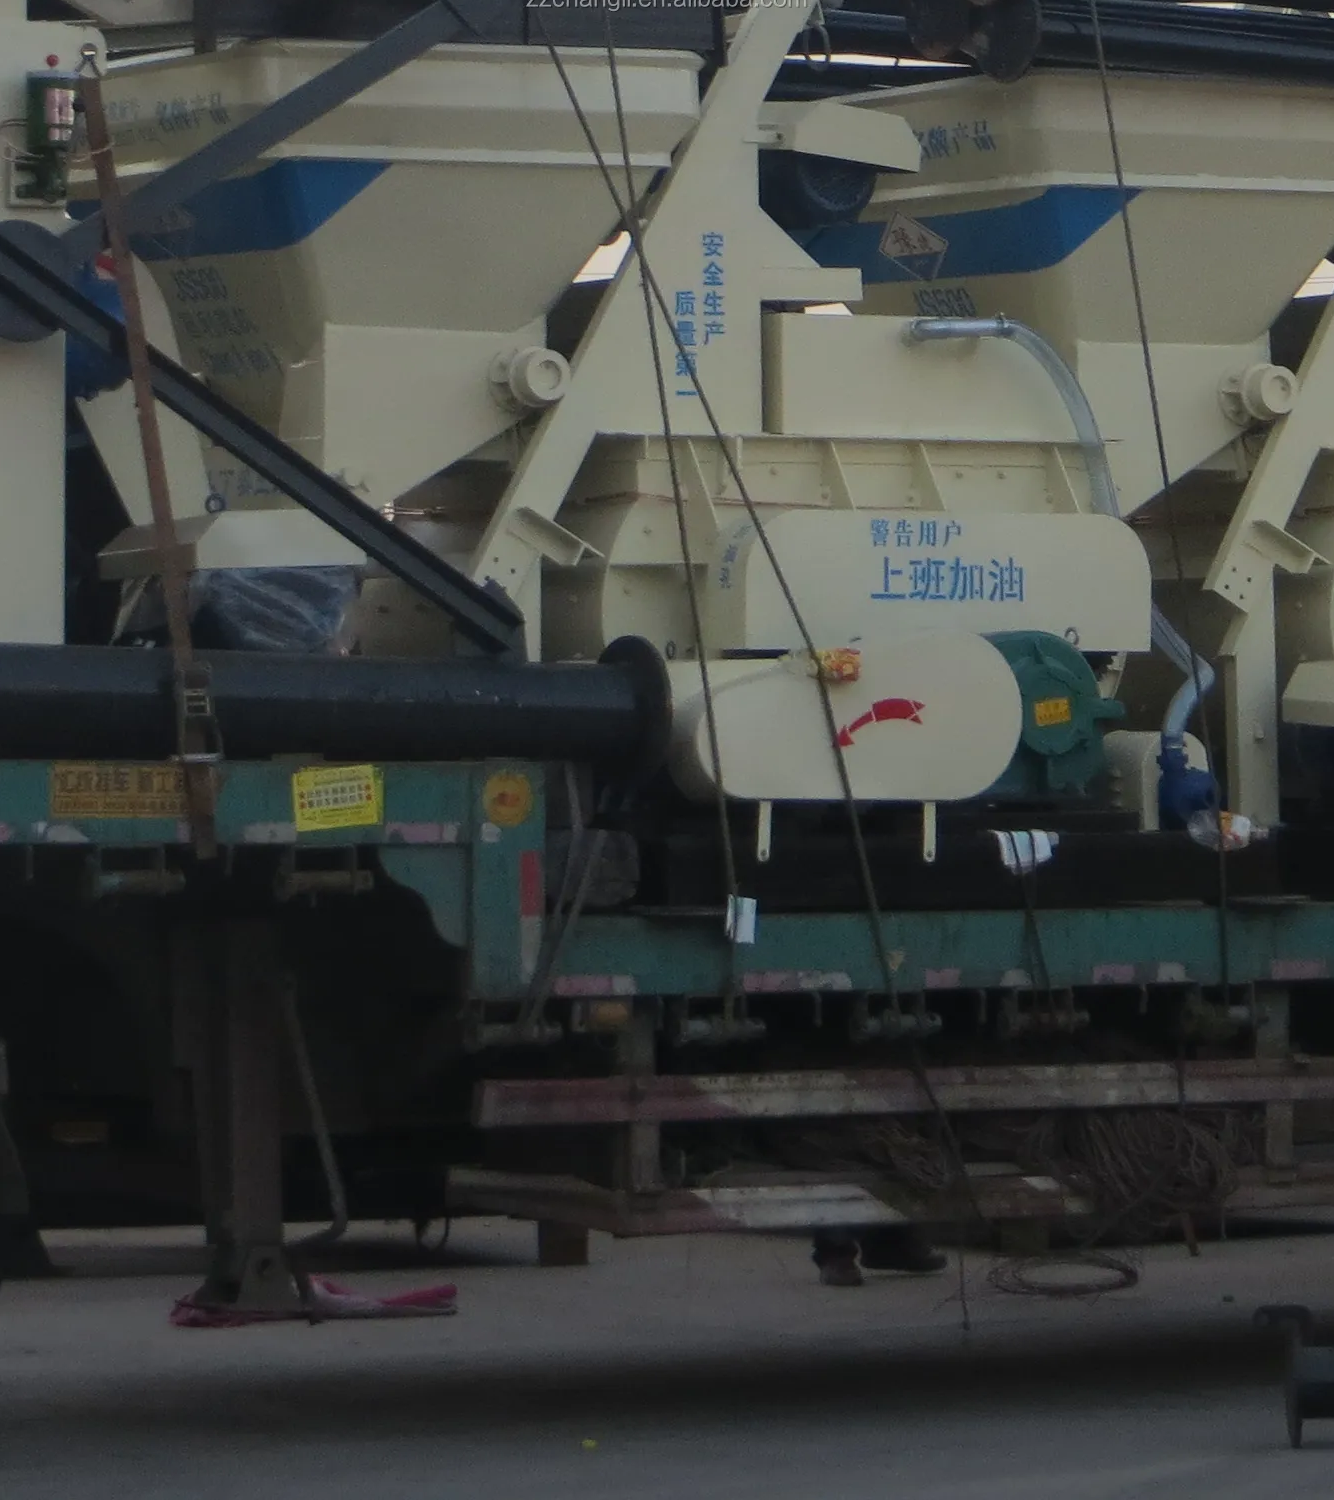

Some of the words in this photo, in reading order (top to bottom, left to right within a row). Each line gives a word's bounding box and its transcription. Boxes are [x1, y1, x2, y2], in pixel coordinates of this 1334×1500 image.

[702, 231, 726, 346] 安全生产
[674, 290, 699, 397] 质量第一
[869, 519, 963, 548] 警告用户
[870, 556, 1025, 603] 上班加油
